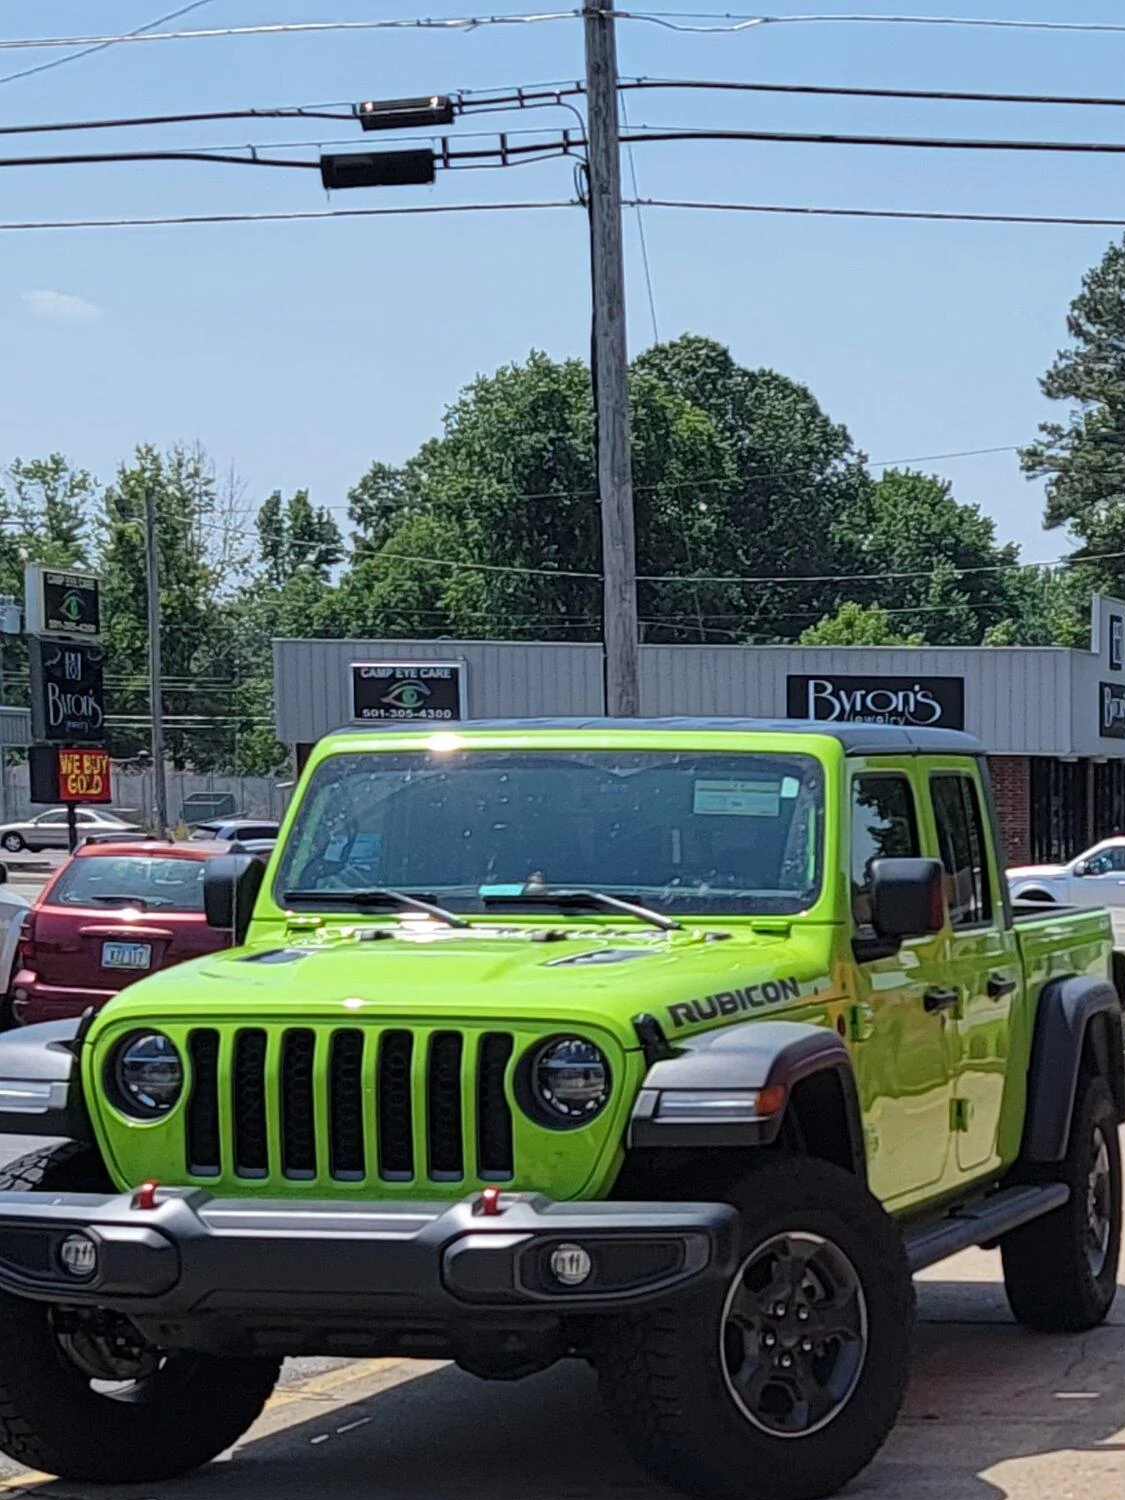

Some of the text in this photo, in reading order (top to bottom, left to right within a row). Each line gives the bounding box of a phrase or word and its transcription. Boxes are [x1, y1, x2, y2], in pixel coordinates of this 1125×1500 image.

[361, 668, 452, 678] CAMP EYE CARE
[808, 680, 942, 725] Byron's
[362, 708, 452, 719] 501-305-4300
[60, 754, 108, 775] WE BUY
[68, 774, 102, 794] GOLD
[666, 976, 801, 1028] RUBICON
